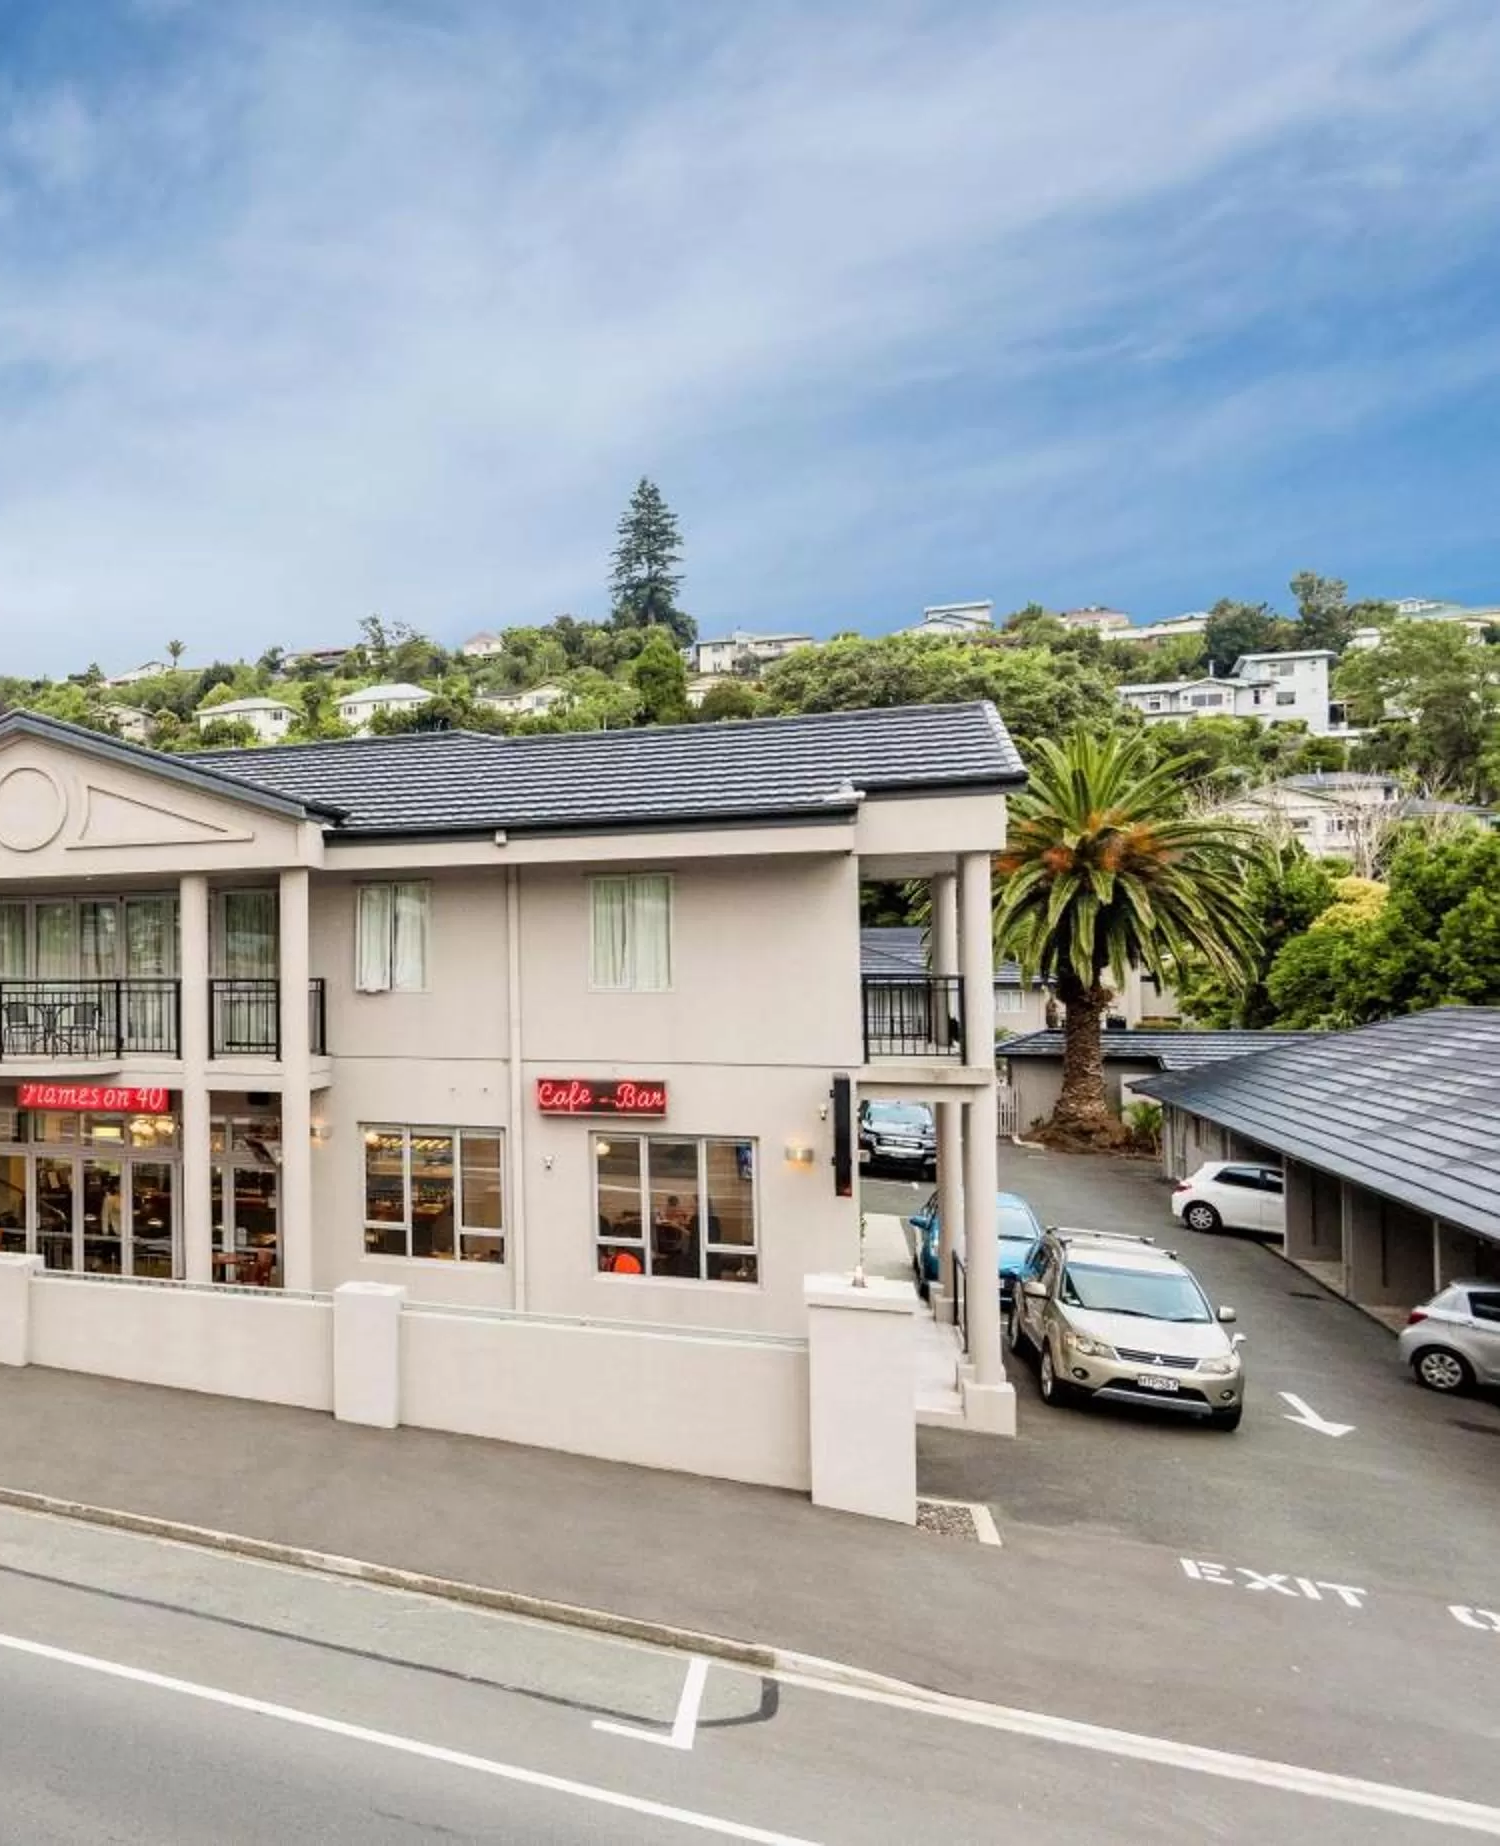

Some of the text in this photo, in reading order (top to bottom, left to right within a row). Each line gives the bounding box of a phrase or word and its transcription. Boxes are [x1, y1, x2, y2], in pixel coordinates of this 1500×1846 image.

[103, 1087, 129, 1107] on
[135, 1087, 163, 1109] 40
[538, 1082, 591, 1112] Cafe
[615, 1083, 666, 1108] Bar
[1180, 1557, 1368, 1608] EXIT
